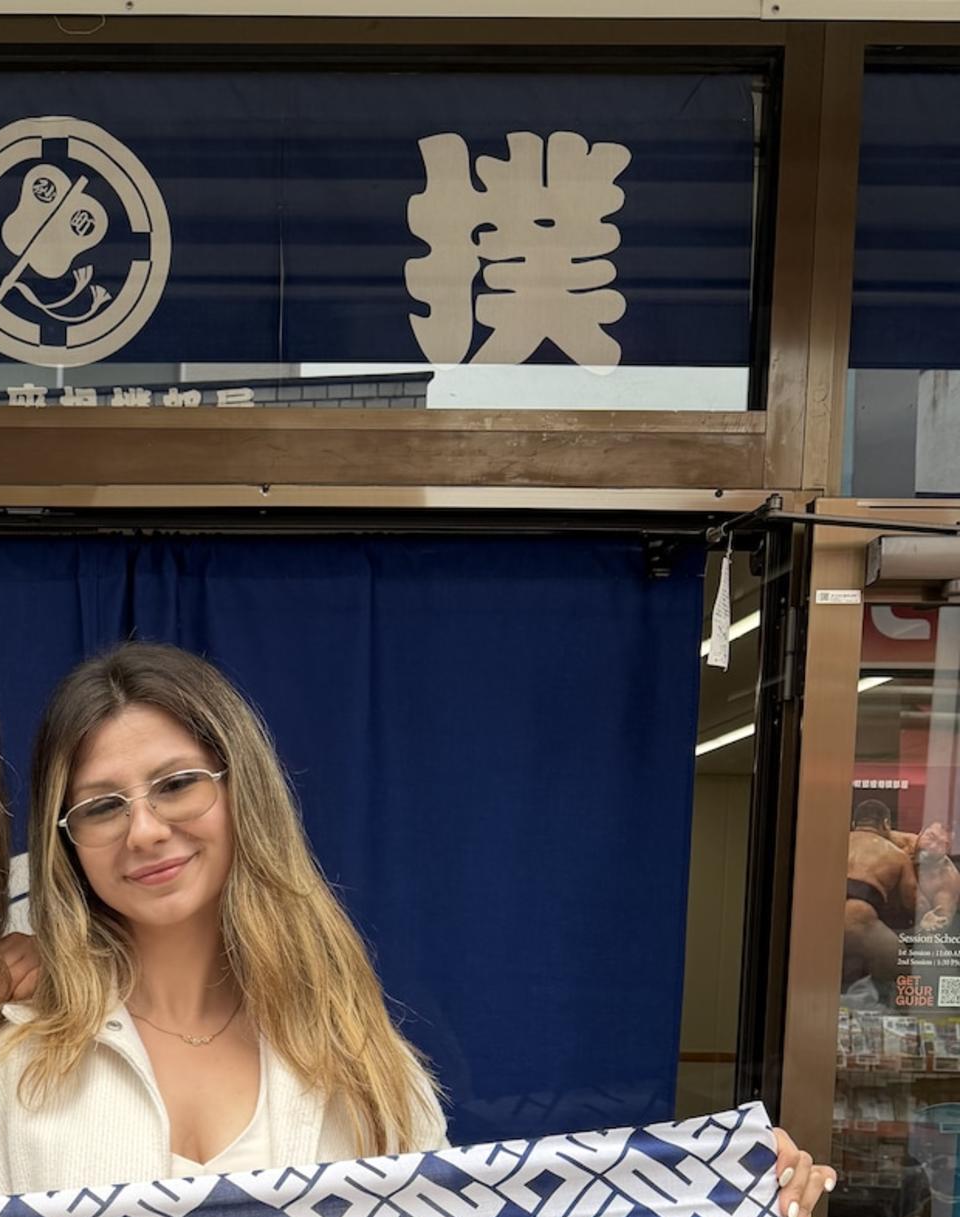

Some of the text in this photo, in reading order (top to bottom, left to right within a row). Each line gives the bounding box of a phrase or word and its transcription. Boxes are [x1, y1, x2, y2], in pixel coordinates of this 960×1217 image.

[404, 130, 632, 376] 撲
[899, 933, 933, 943] Session
[897, 976, 921, 986] GET
[897, 986, 933, 995] YOUR
[896, 996, 934, 1006] GUIDE
